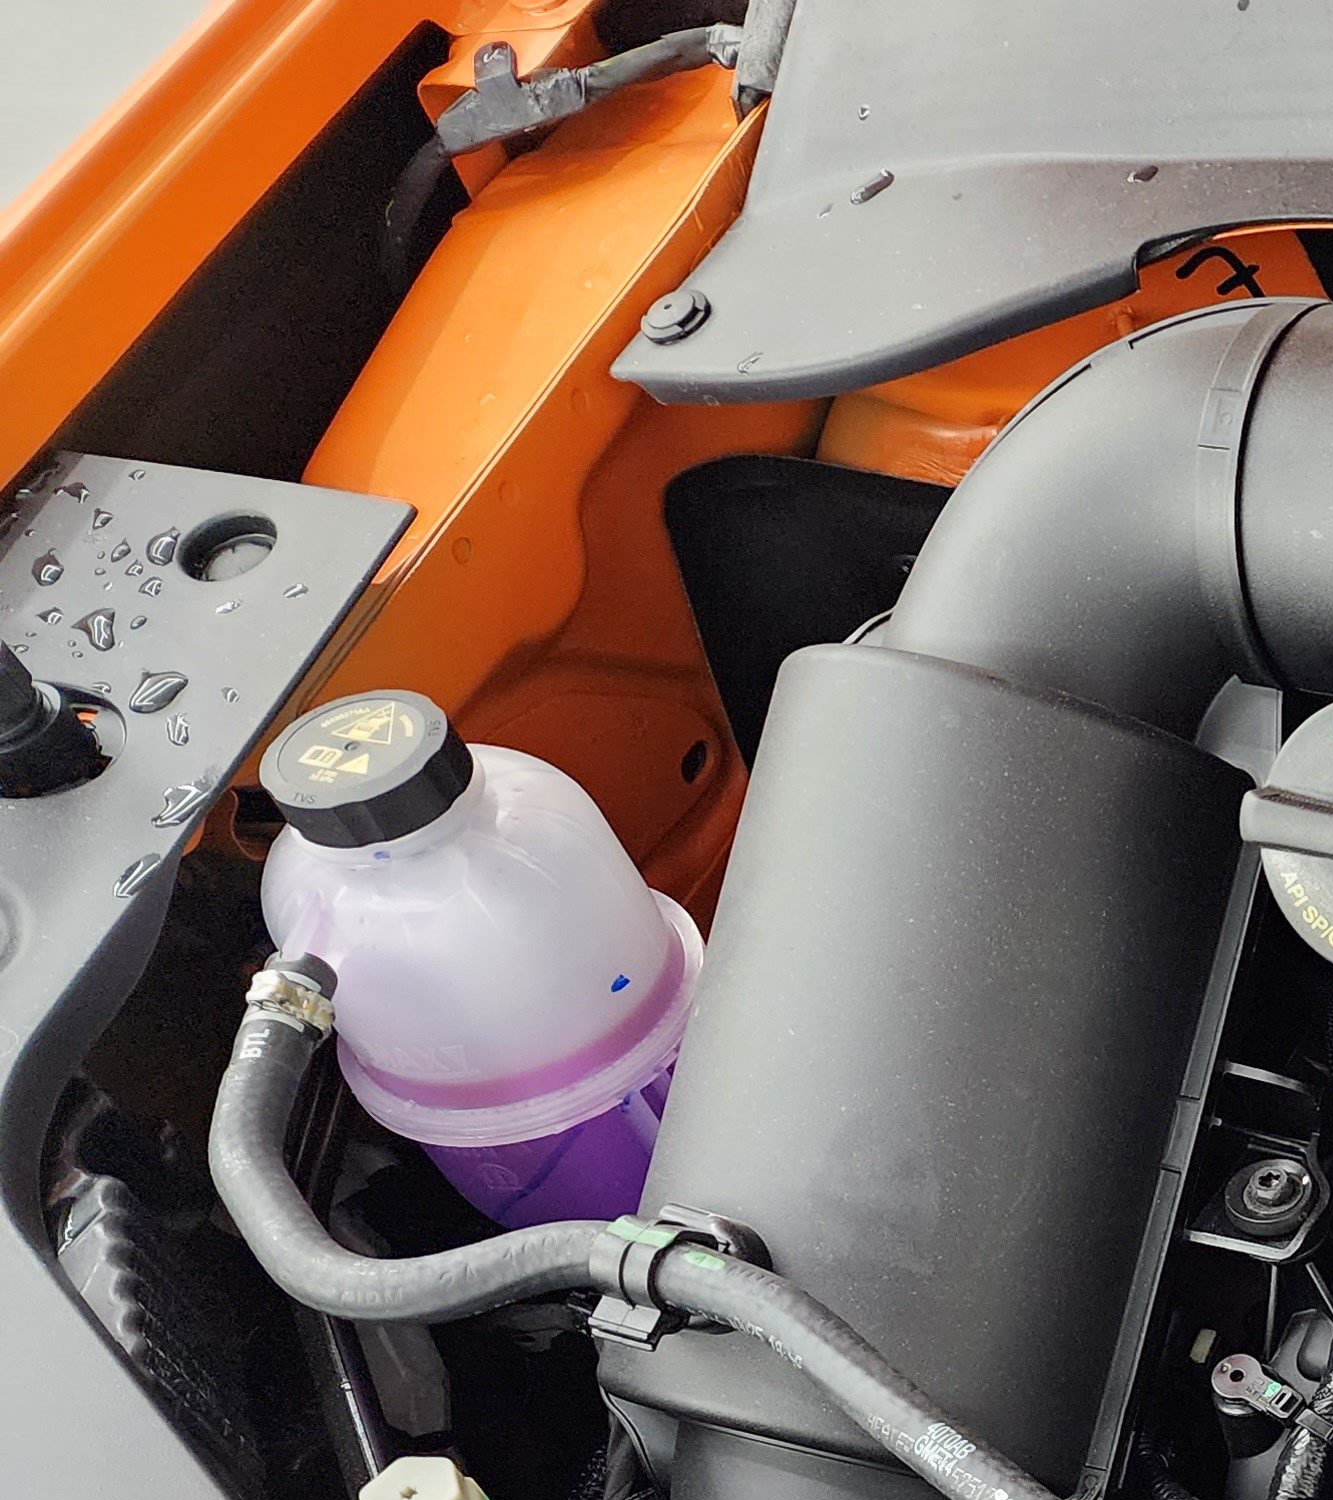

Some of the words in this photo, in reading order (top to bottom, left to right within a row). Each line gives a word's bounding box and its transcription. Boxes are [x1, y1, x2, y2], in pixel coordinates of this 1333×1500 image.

[293, 792, 317, 804] TVS
[1280, 870, 1308, 907] API
[239, 1028, 271, 1060] BTL
[927, 1422, 976, 1460] 4070AB
